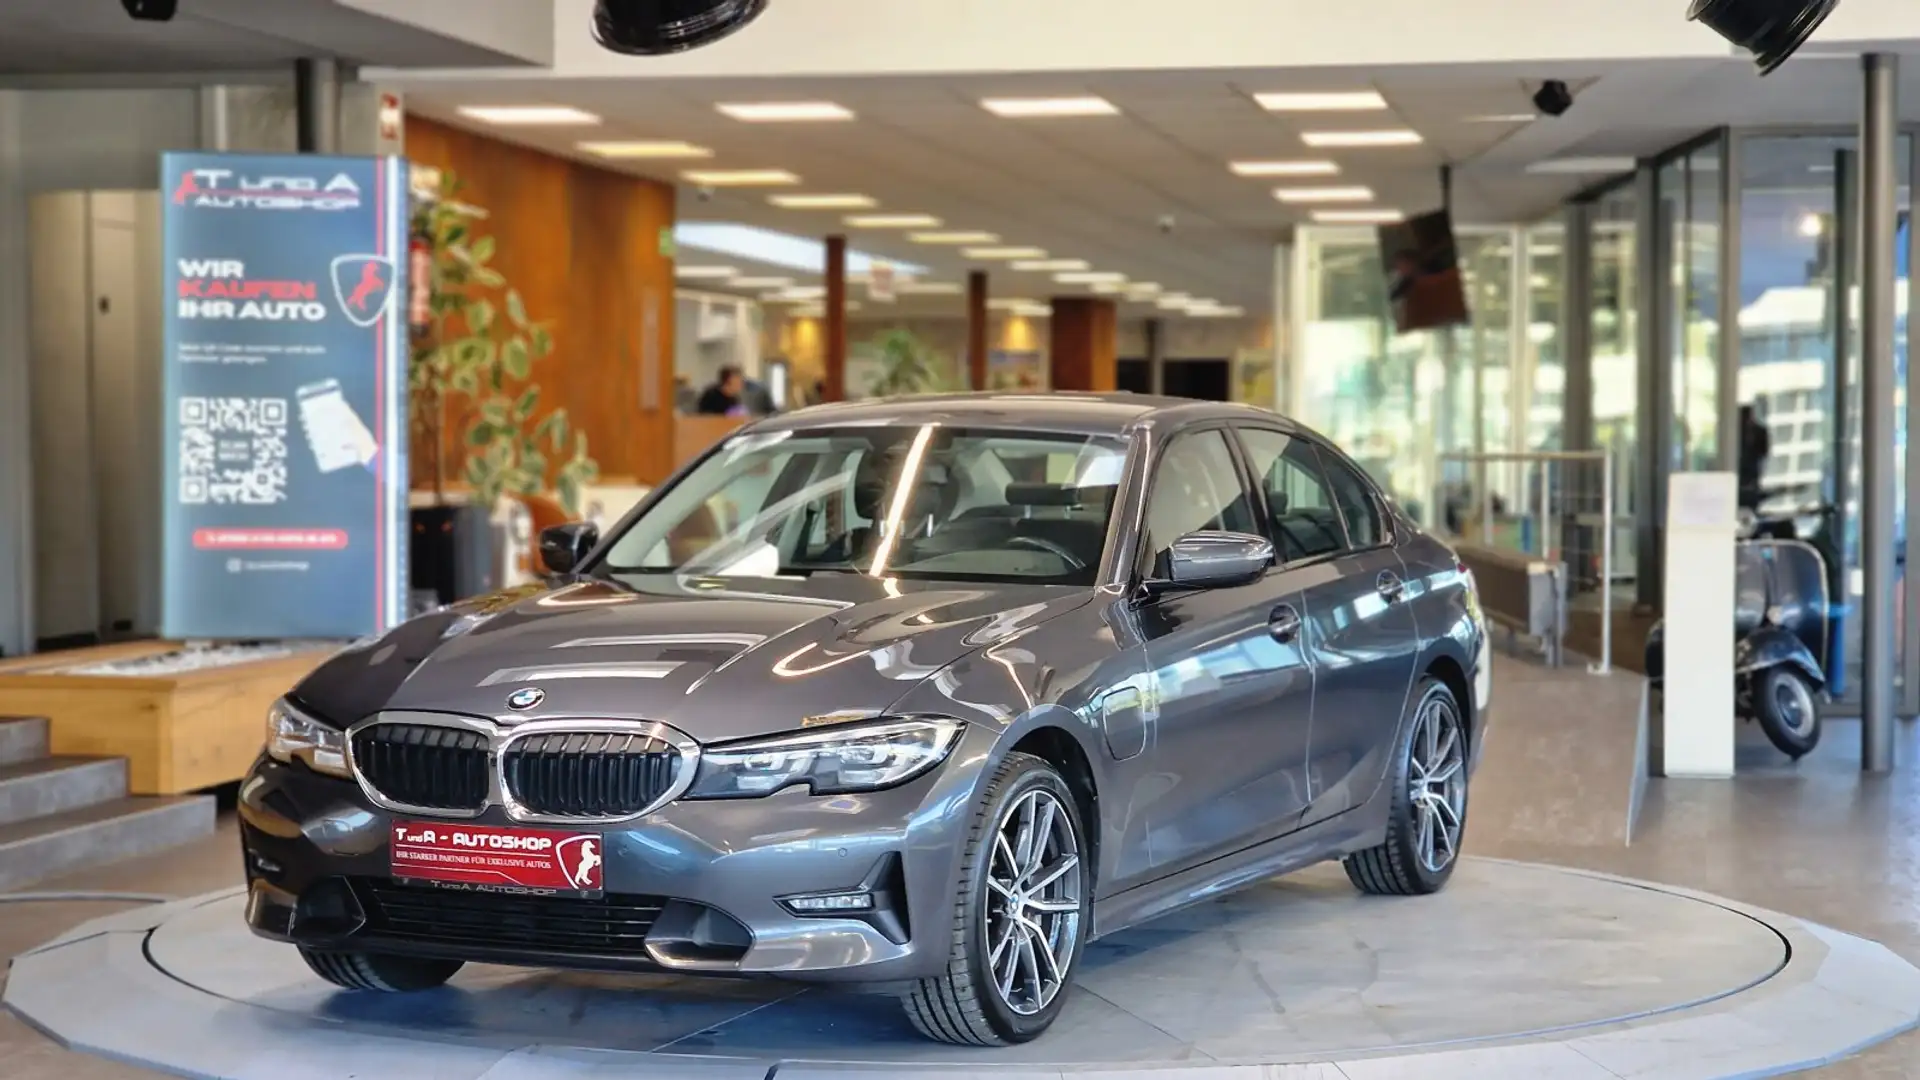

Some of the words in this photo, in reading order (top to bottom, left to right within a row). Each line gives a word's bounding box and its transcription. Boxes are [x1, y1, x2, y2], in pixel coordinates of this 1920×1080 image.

[177, 258, 244, 279] WIR
[177, 279, 317, 300] KAUFEN
[177, 299, 234, 320] IHR
[238, 301, 327, 321] AUTO
[452, 832, 552, 850] AUTOSHOP
[409, 851, 438, 862] STARKER
[438, 855, 470, 864] PARTNER
[471, 856, 486, 865] FÜR
[487, 857, 526, 868] EXKLUSIVE
[526, 860, 552, 869] AUTOS
[475, 884, 557, 896] AUTOSHOP
